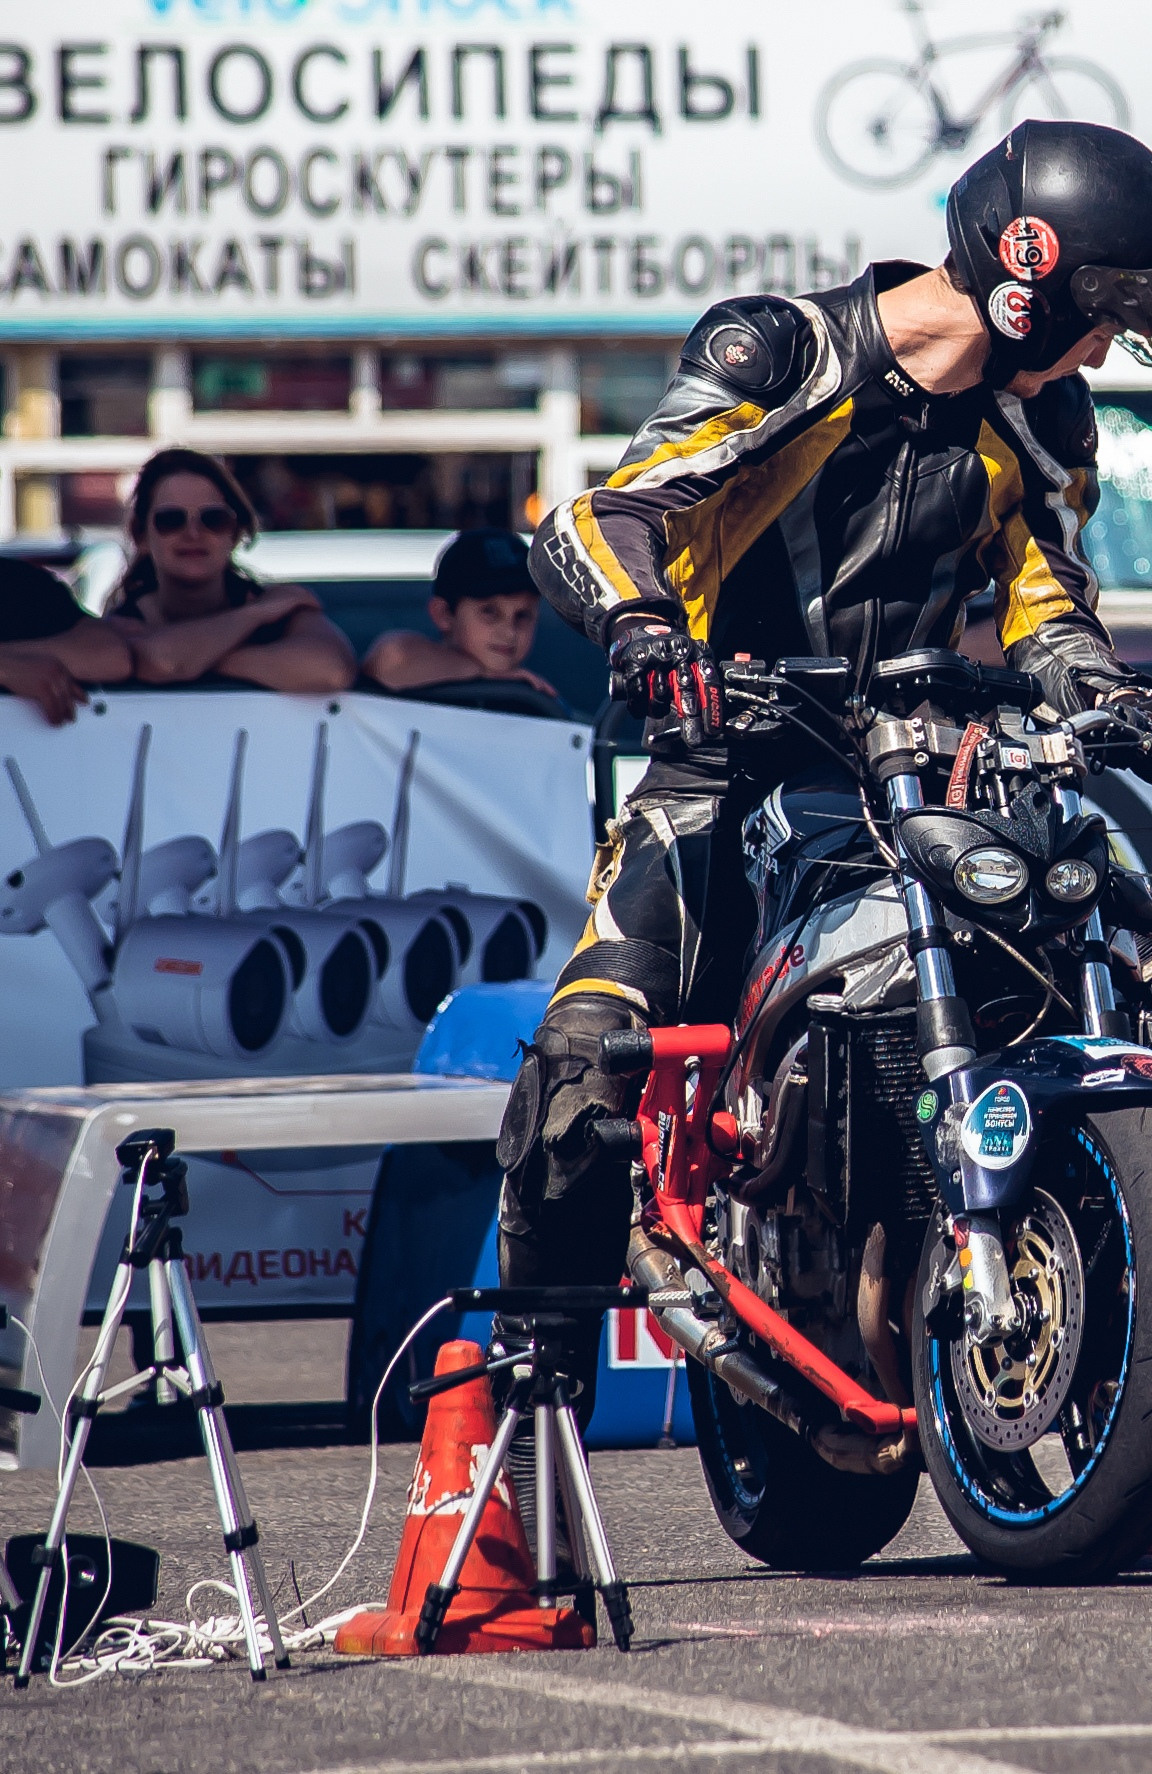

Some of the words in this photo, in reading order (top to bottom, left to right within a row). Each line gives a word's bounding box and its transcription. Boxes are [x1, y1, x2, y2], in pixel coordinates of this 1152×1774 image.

[0, 42, 762, 136] ВЕЛОСИПЕДЫ
[102, 146, 645, 217] ГИРОСКУТЕРЫ
[0, 233, 358, 299] АМОКАТЫ
[412, 220, 862, 299] СКЕЙТБОРДЫ
[1014, 229, 1043, 268] 19
[708, 685, 721, 728] DUCATI
